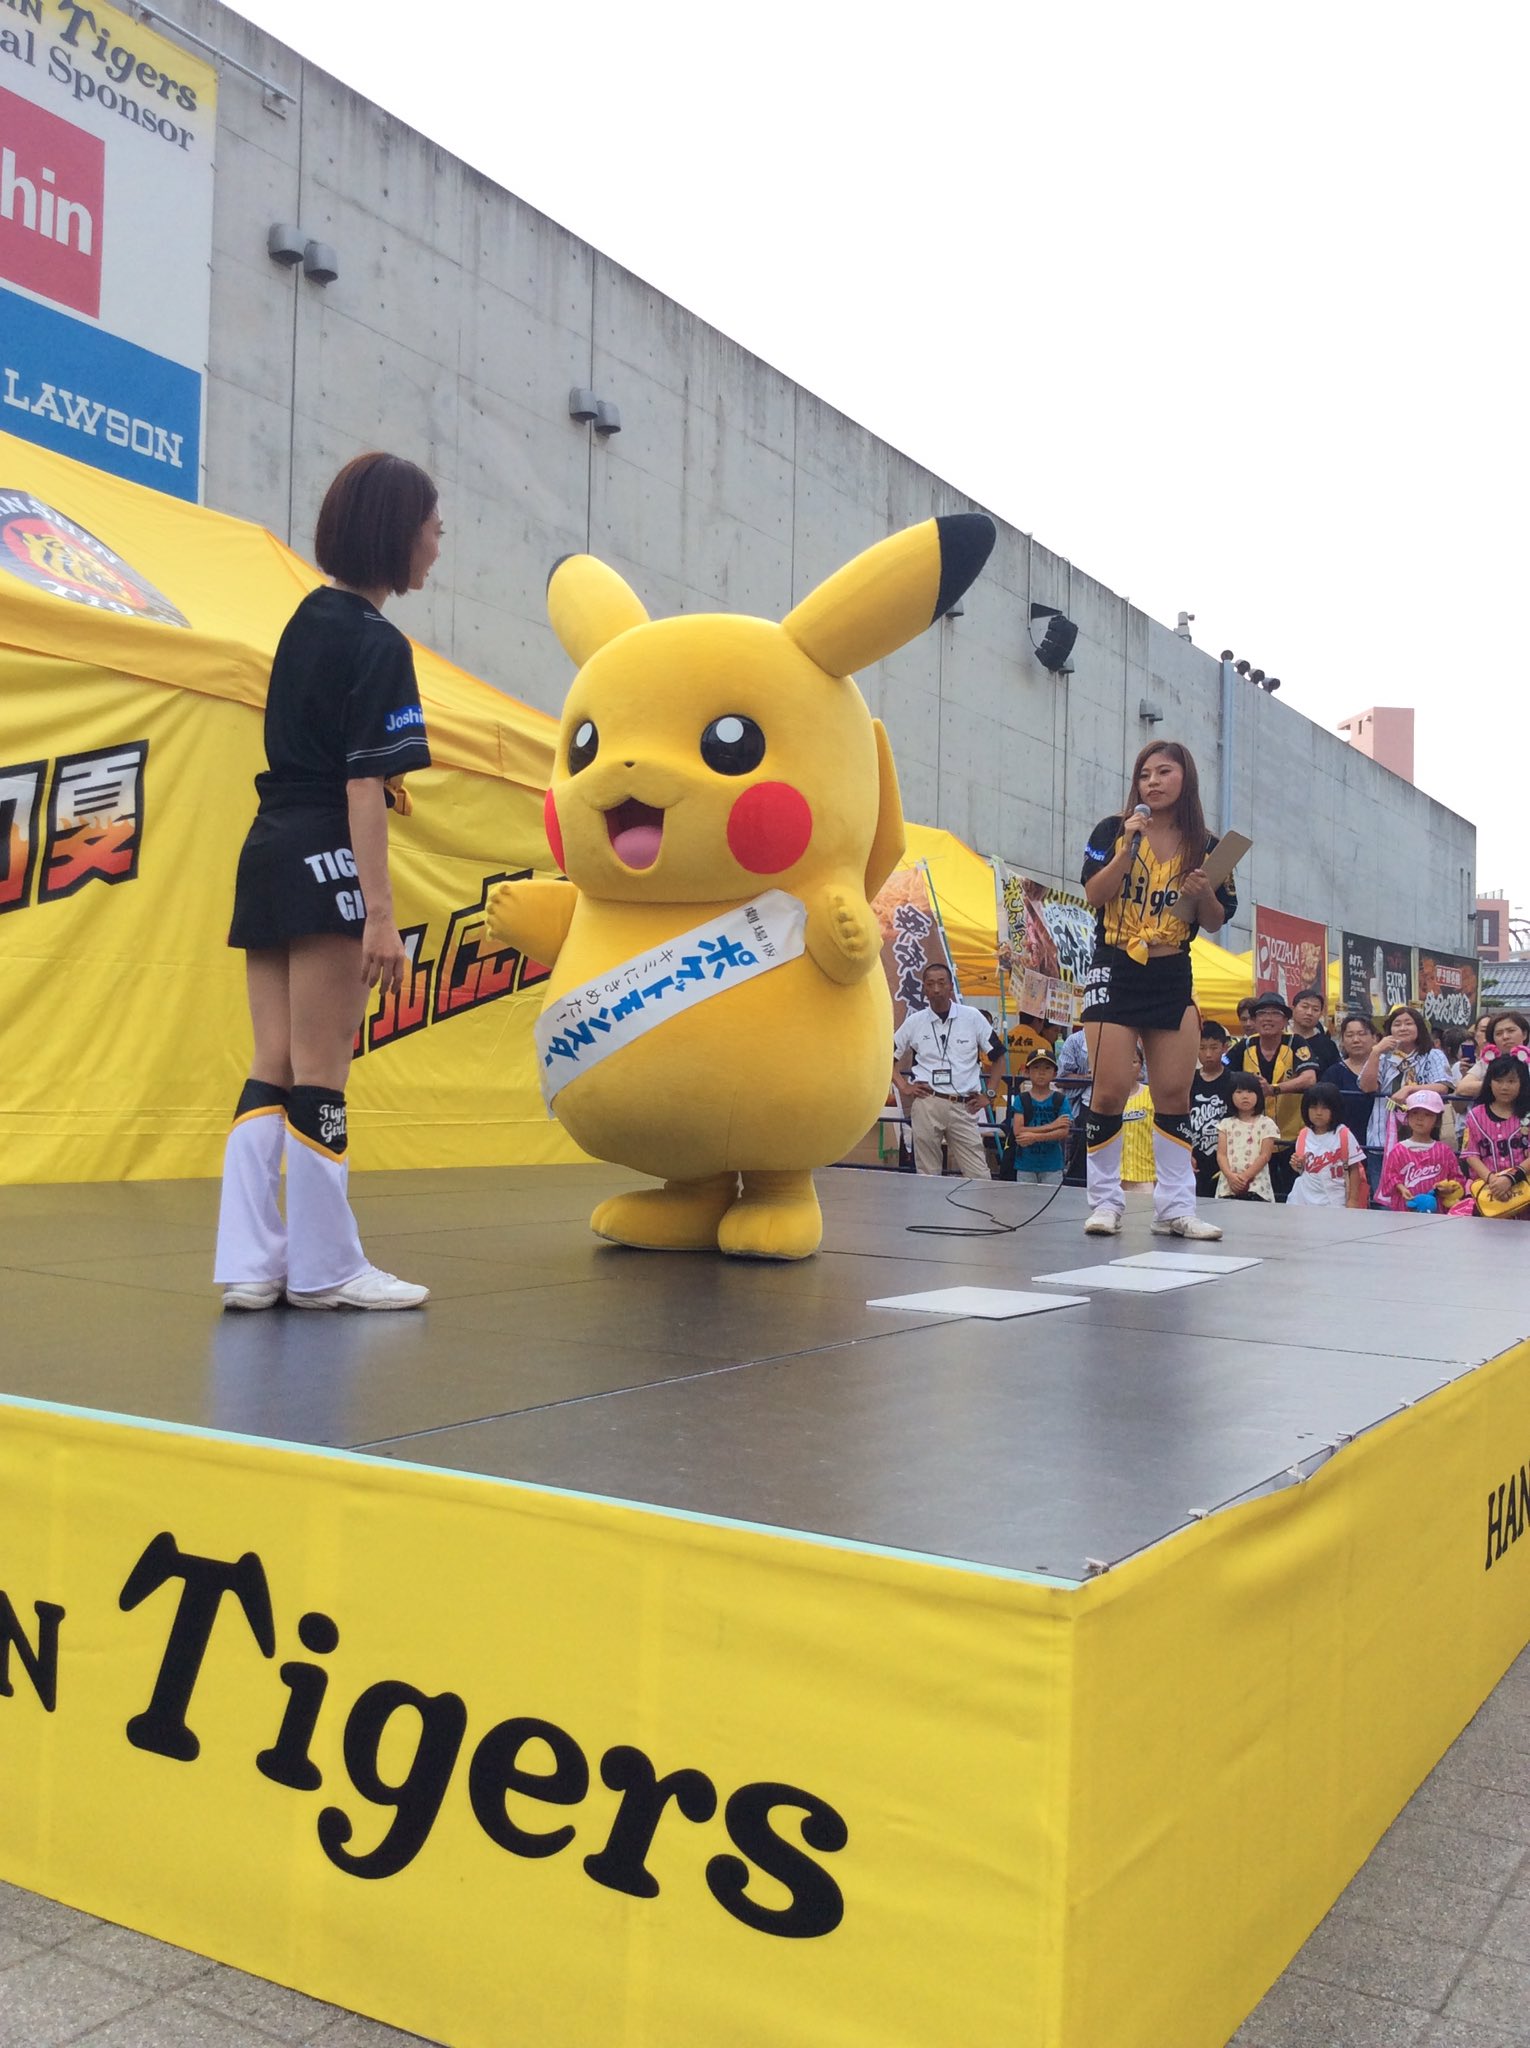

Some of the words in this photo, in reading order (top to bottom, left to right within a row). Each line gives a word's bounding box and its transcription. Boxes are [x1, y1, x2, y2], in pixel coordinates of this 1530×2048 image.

[0, 30, 36, 67] al
[48, 46, 195, 152] Sponsor
[58, 0, 198, 111] Tigers
[0, 147, 93, 256] hin
[4, 368, 183, 468] LAWSON
[304, 848, 358, 884] TIG
[336, 890, 365, 921] GI
[744, 906, 776, 958] 劇場版
[1386, 970, 1407, 988] EXTRA
[545, 934, 760, 1067] ポケットモンスター
[1401, 1161, 1441, 1188] Tigers
[118, 1531, 849, 1938] Tigers
